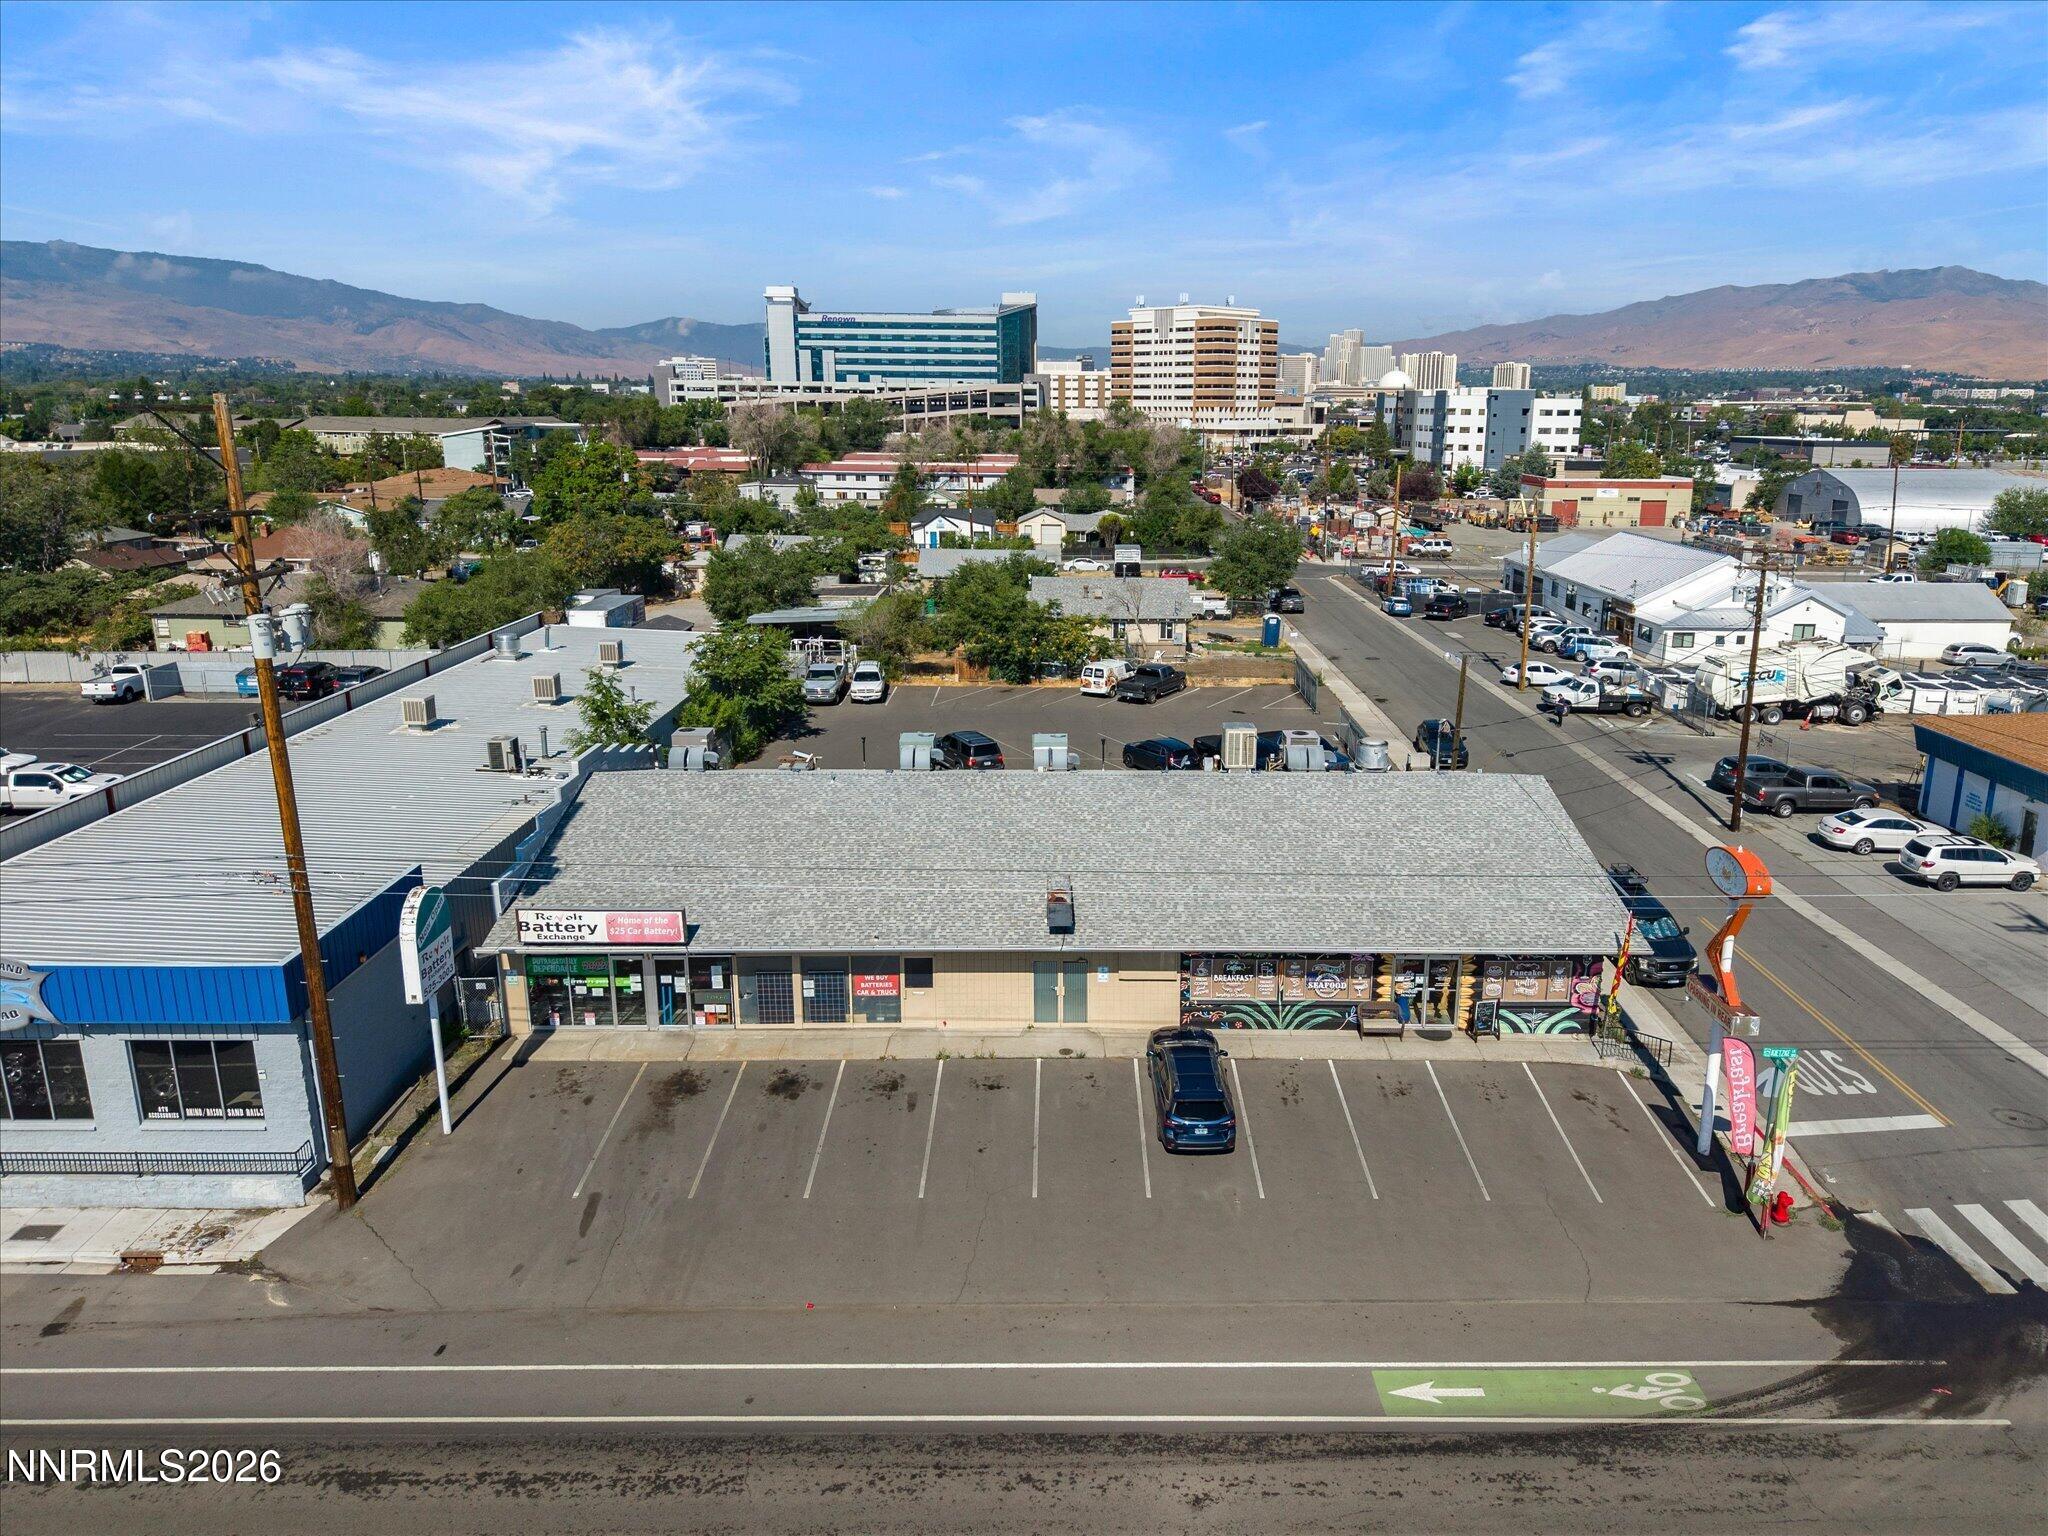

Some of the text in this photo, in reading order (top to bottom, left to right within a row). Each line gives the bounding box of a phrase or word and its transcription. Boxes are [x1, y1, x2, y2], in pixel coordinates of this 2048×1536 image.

[821, 314, 856, 323] Renown
[617, 916, 668, 924] Home of the
[519, 921, 598, 936] Battery
[609, 927, 626, 936] $25
[643, 928, 678, 937] Battery!
[536, 933, 586, 941] Exchange
[421, 947, 452, 980] Battery
[533, 965, 578, 973] DEPENDABLE
[1213, 974, 1254, 982] BREAKFAST
[1308, 981, 1347, 989] SEAFOOD
[227, 1109, 244, 1117] SAND
[246, 1109, 264, 1117] RAILS
